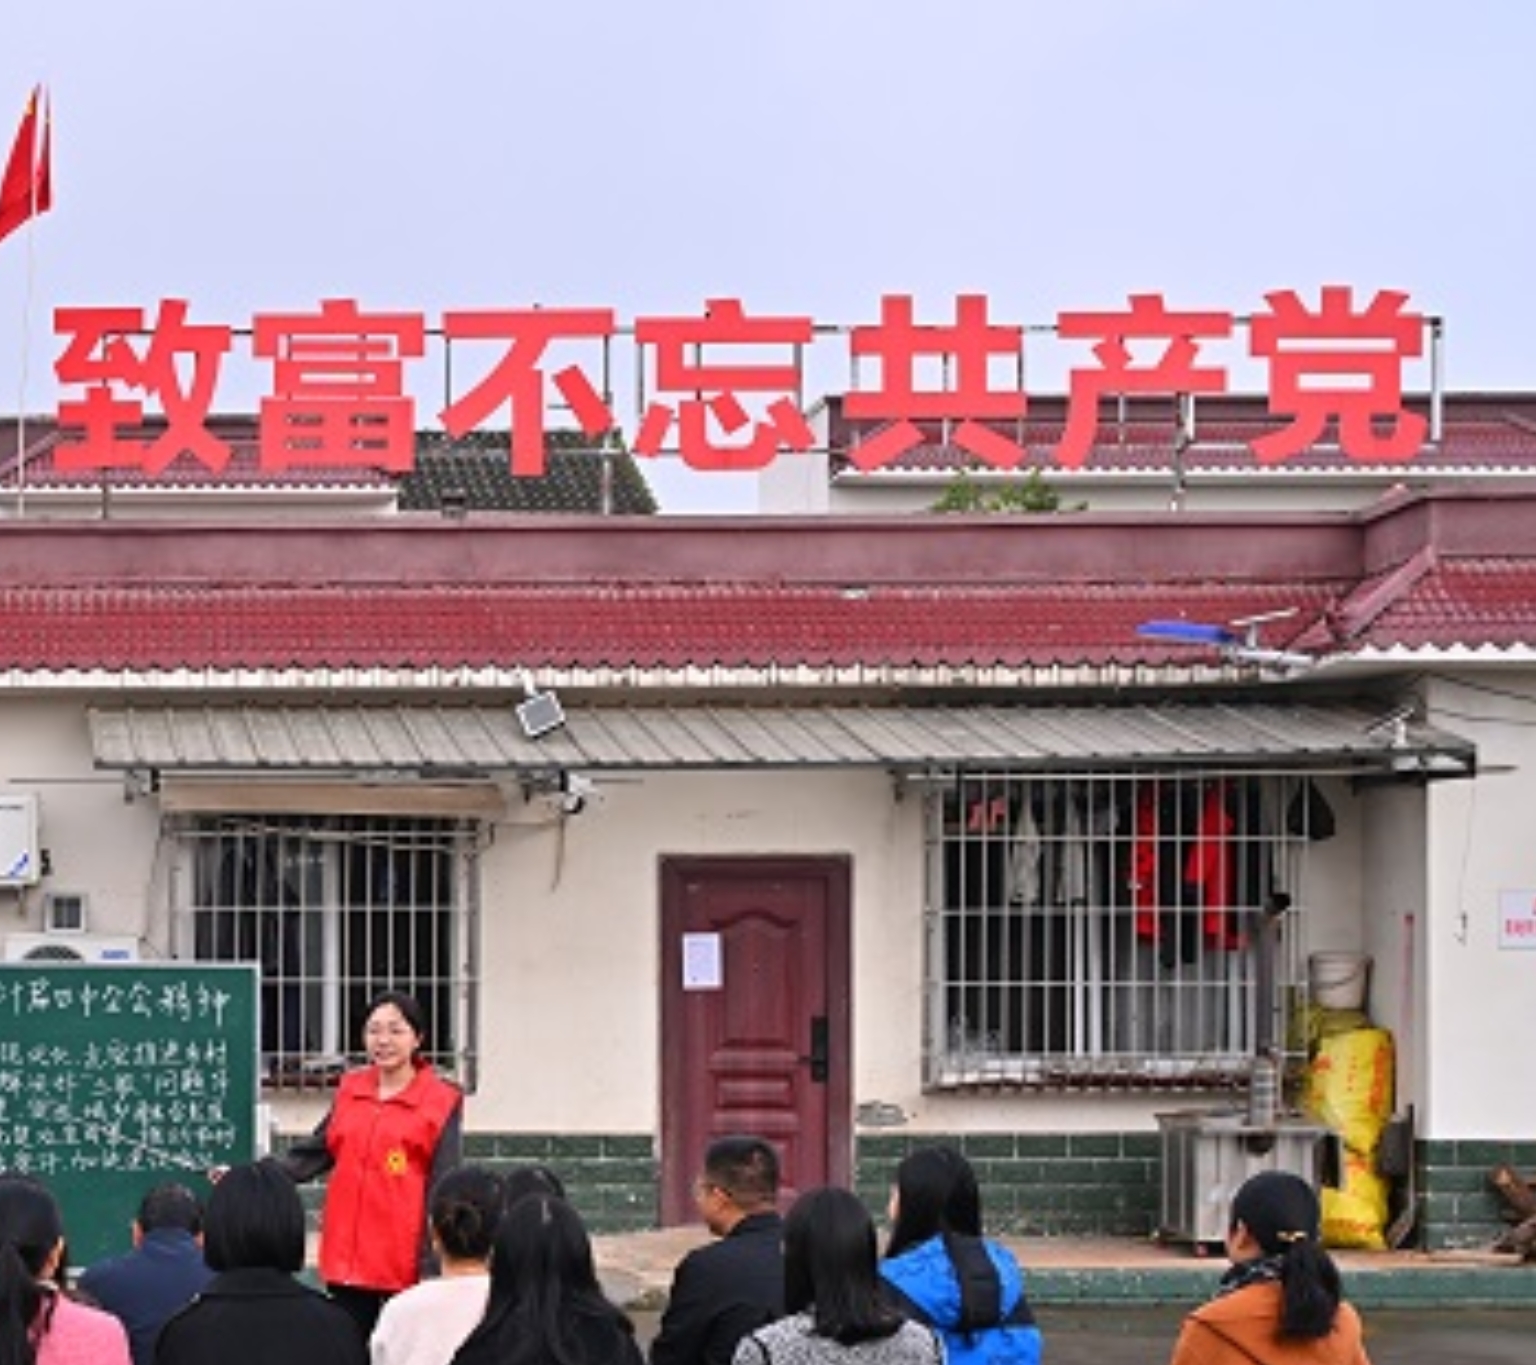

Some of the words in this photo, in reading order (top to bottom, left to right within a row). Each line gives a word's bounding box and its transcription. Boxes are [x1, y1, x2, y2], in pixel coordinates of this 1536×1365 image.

[52, 286, 1427, 477] 致富不忘共产党
